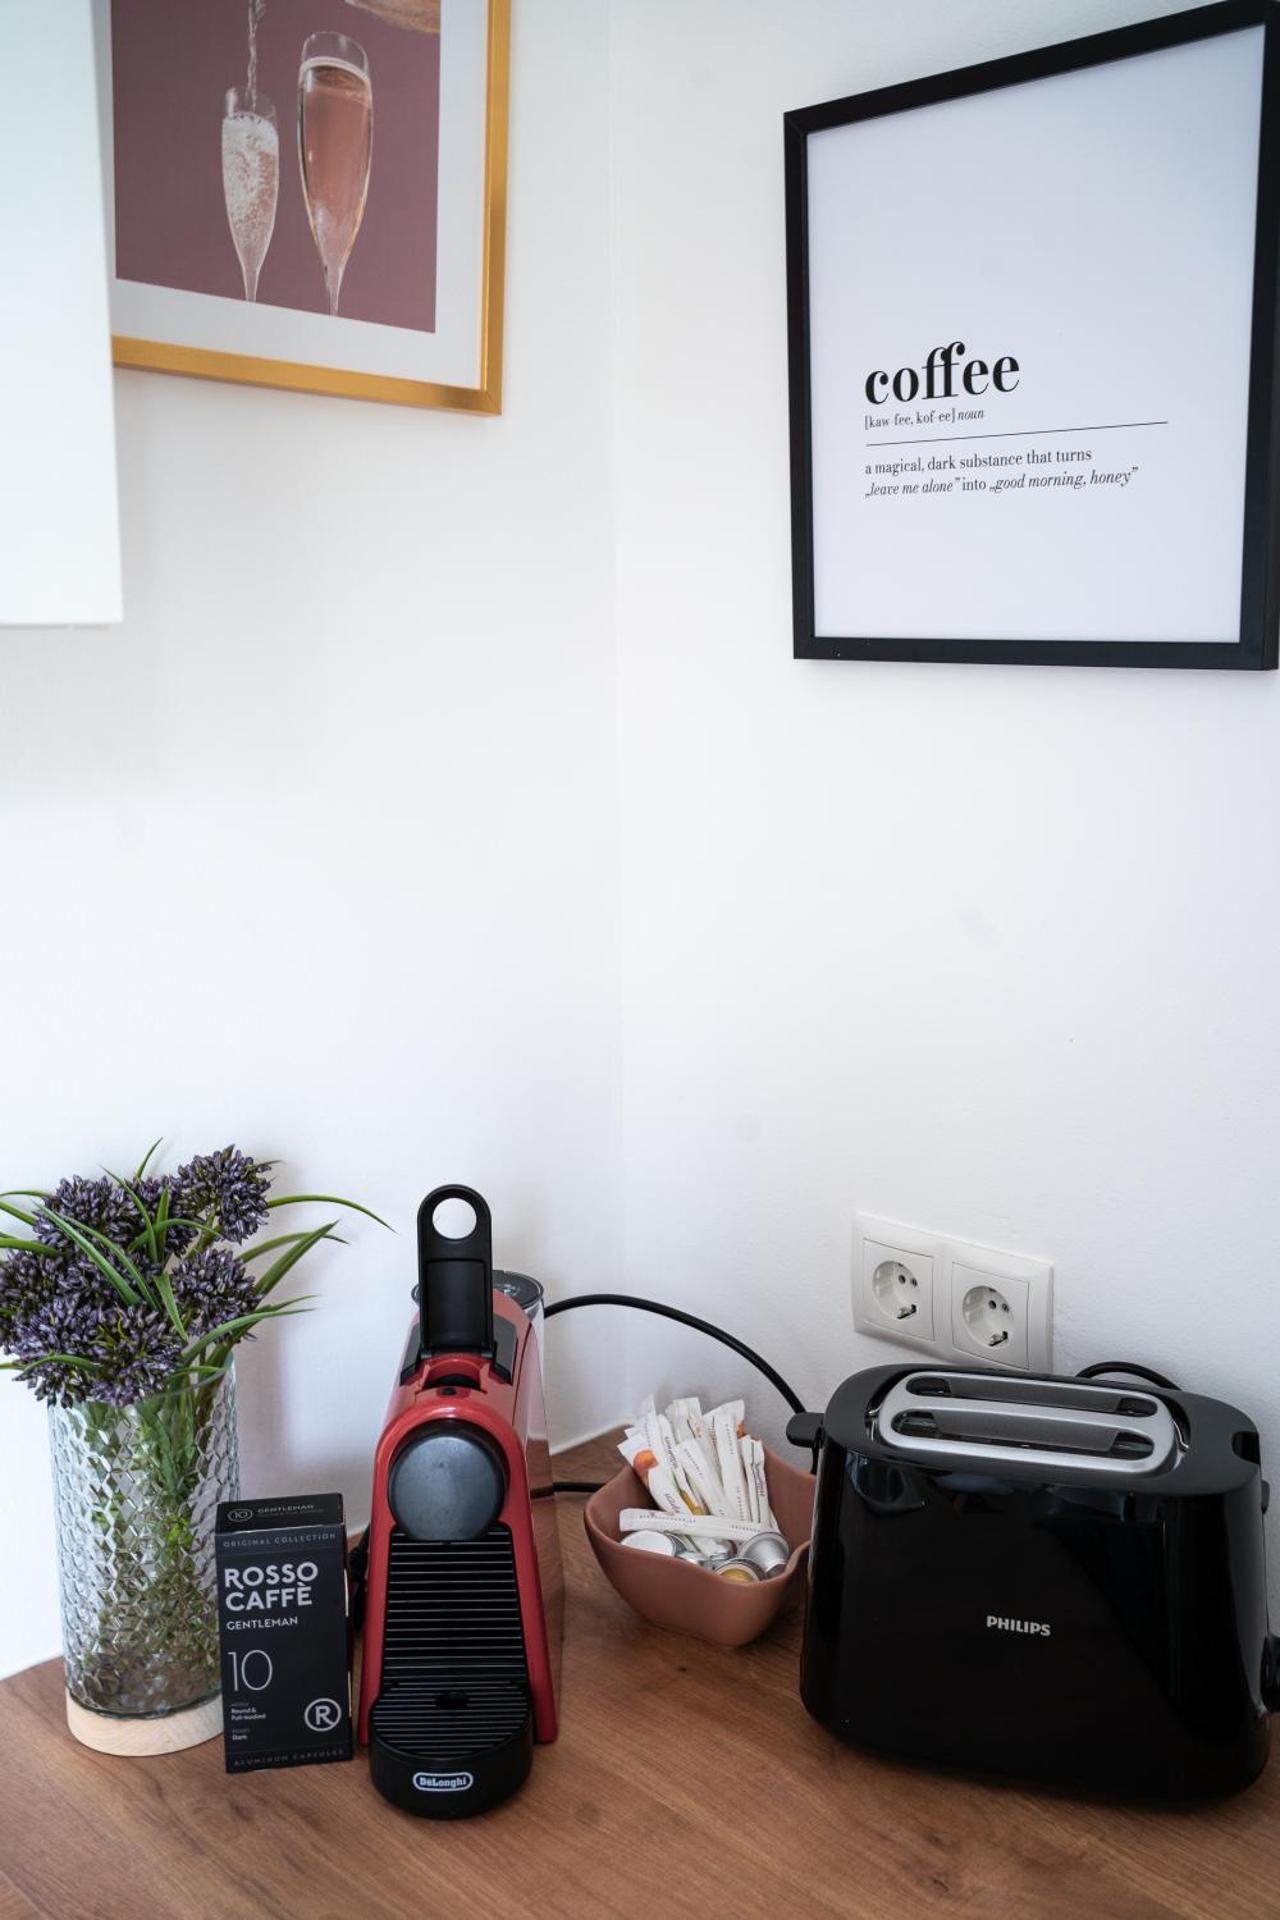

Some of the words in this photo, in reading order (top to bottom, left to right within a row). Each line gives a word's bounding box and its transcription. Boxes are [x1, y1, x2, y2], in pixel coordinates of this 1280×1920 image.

[865, 341, 1019, 405] coffee
[957, 409, 984, 421] noun
[865, 464, 872, 474] a
[875, 457, 925, 477] magical,
[927, 456, 956, 471] dark
[959, 453, 1023, 470] substance
[1026, 449, 1052, 465] that
[1056, 450, 1092, 463] turns
[901, 484, 919, 495] me
[962, 477, 987, 491] into
[1028, 471, 1087, 490] morning,
[223, 1540, 271, 1548] ORIGINAL
[274, 1533, 336, 1544] COLLECTION
[224, 1562, 319, 1590] ROSSO
[225, 1582, 313, 1612] CAFFÈ
[226, 1616, 298, 1631] GENTLEMAN
[986, 1615, 1052, 1637] PHILIPS
[227, 1649, 273, 1692] 10
